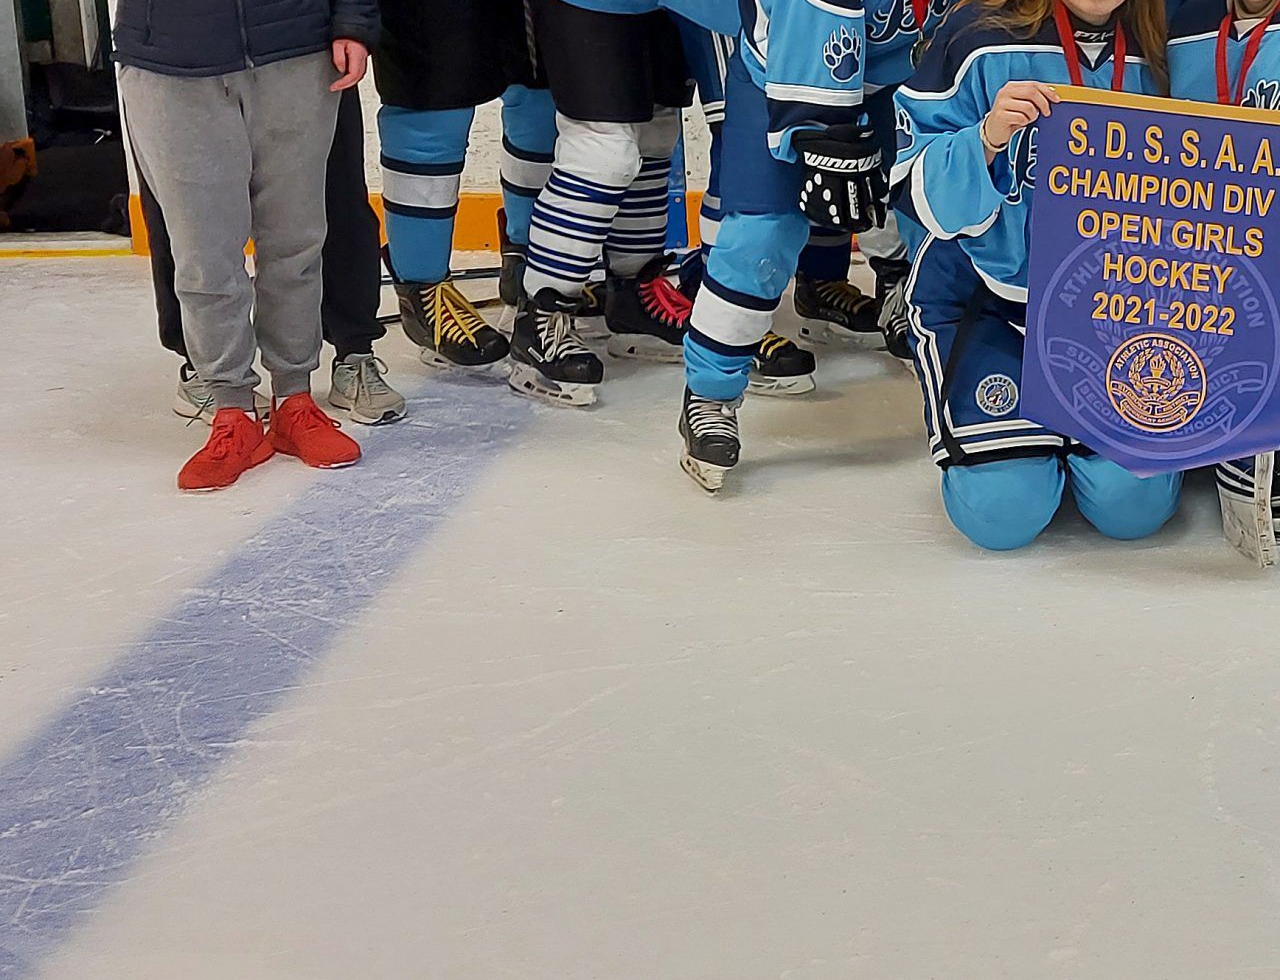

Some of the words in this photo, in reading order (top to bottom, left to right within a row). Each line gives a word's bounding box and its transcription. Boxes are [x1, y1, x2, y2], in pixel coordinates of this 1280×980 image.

[1068, 117, 1095, 156] S.
[1105, 121, 1134, 161] D.
[1143, 125, 1170, 165] S.
[1180, 129, 1207, 169] S.
[1214, 134, 1245, 173] A.
[1048, 165, 1214, 211] CHAMPION
[1223, 184, 1276, 217] DIV
[1076, 209, 1163, 246] OPEN
[1171, 220, 1265, 258] GIRLS
[1103, 252, 1234, 294] HOCKEY
[1091, 291, 1237, 337] 2021-2022
[1114, 339, 1150, 371] ATHLETIC
[1152, 339, 1200, 380] ASSOCIATION
